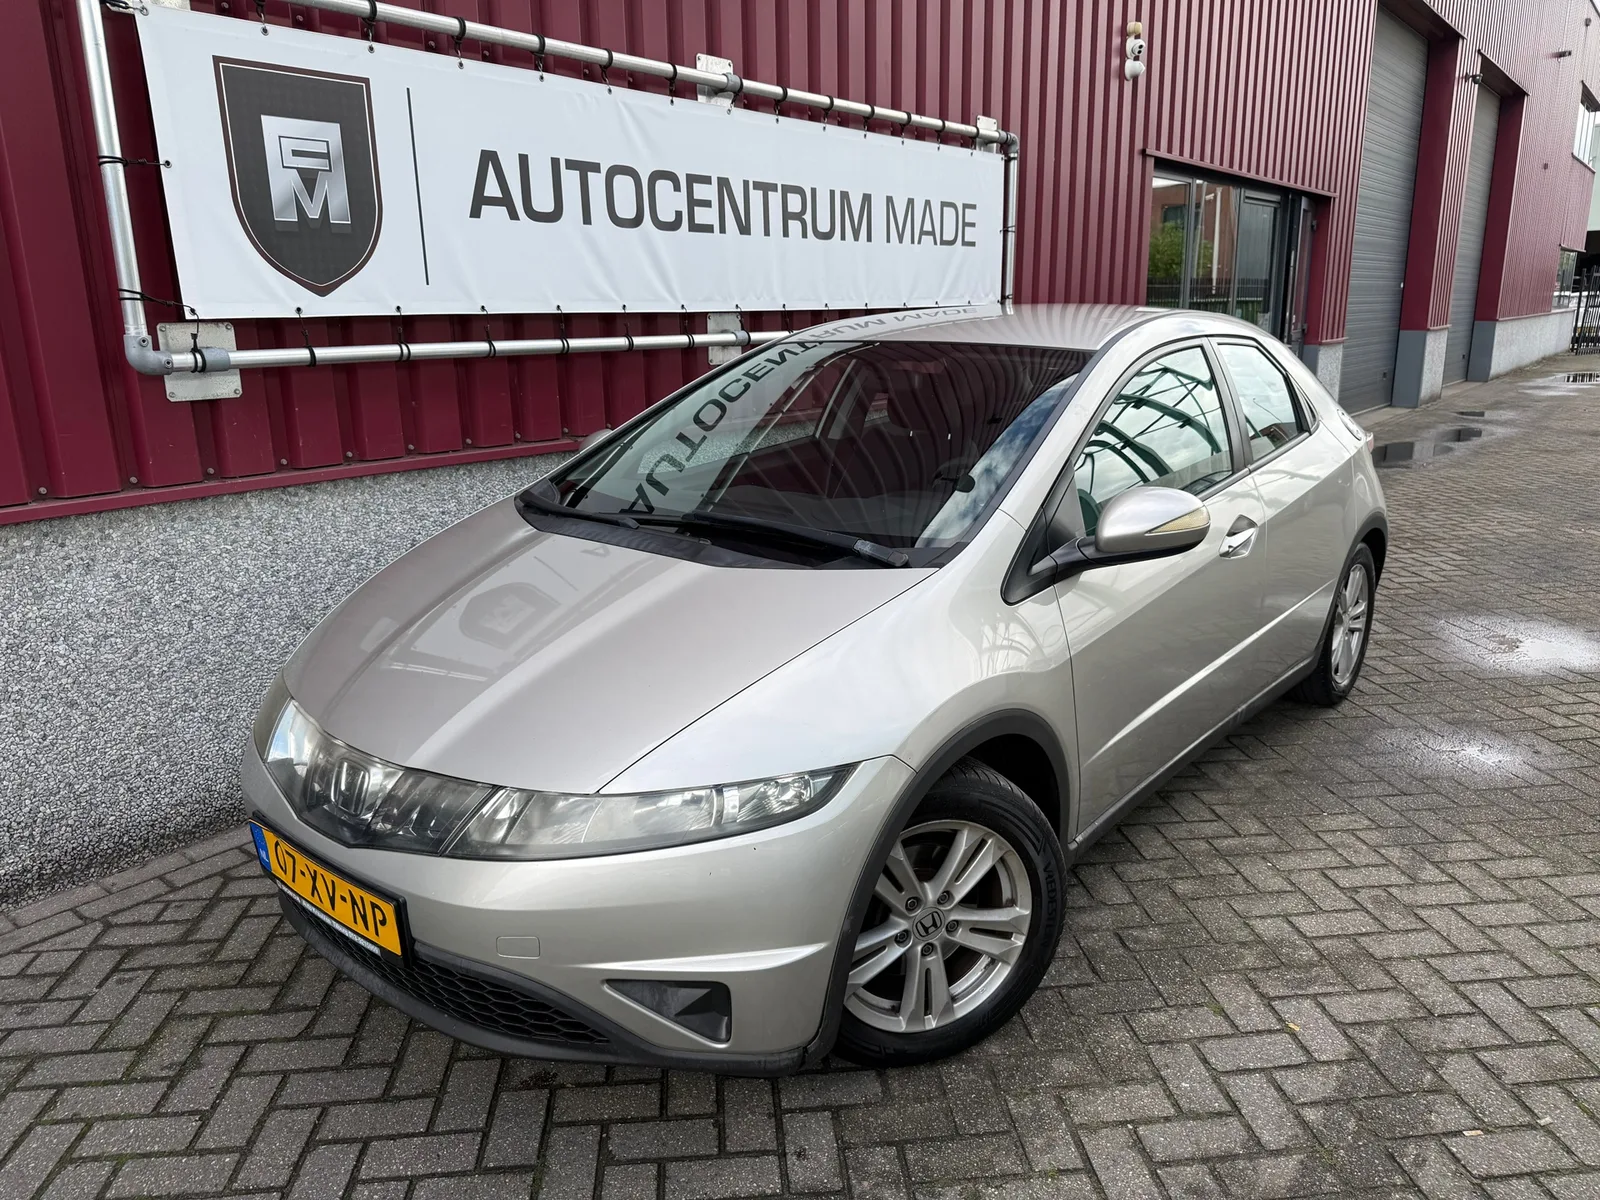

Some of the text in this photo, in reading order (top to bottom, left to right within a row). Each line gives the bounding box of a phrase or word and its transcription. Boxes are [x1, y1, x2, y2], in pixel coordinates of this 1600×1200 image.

[469, 148, 977, 248] AUTOCENTRUM MADE
[259, 847, 269, 863] NL
[274, 839, 387, 938] 07-XV-NP
